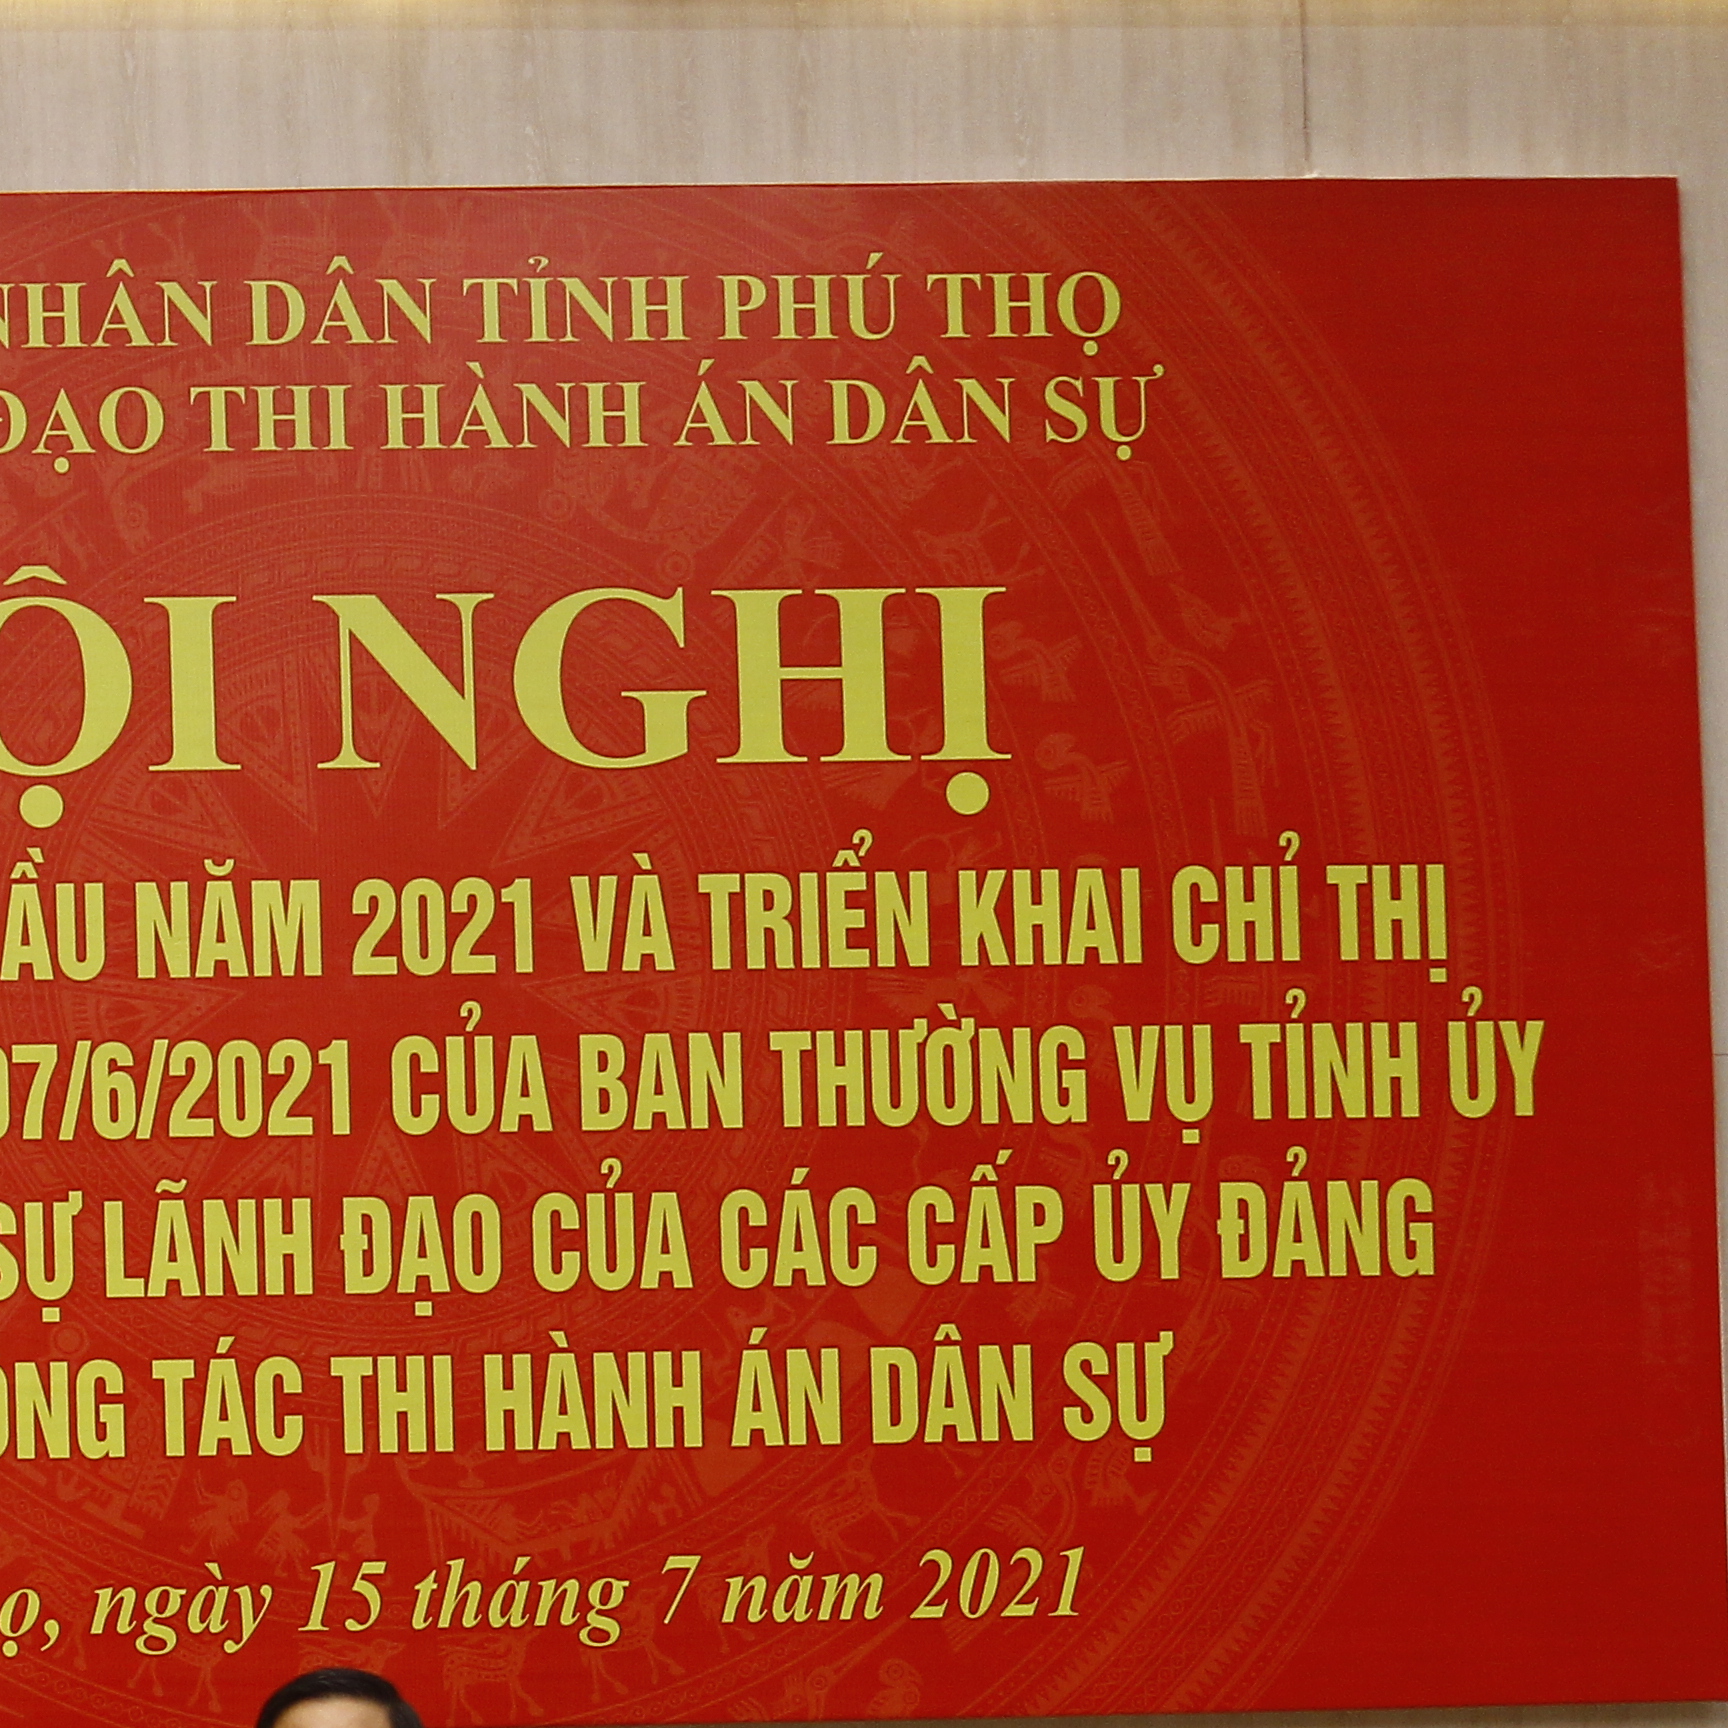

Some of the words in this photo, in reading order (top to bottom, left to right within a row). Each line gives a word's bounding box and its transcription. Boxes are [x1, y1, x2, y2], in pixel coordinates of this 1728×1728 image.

[244, 256, 437, 345] DÂN
[463, 256, 691, 343] TỈNH
[718, 252, 901, 339] PHÚ
[927, 272, 1120, 353] THỌ
[190, 385, 353, 451] THI
[380, 362, 647, 449] HÀNH
[673, 359, 797, 446] ÁN
[825, 356, 1015, 444] DÂN
[1045, 361, 1164, 460] SỰ
[312, 587, 1011, 814] NGHỊ
[135, 859, 322, 978] NĂM
[352, 877, 533, 975] 2021
[570, 853, 675, 972] VÀ
[698, 829, 929, 969] TRIỂN
[959, 868, 1142, 966] KHAI
[1172, 831, 1300, 964] CHỈ
[1327, 864, 1447, 982] THỊ
[392, 1001, 553, 1135] CỦA
[579, 1032, 743, 1130] BAN
[770, 1003, 1087, 1127] THƯỜNG
[1113, 1025, 1213, 1143] VỤ
[1240, 989, 1419, 1119] TỈNH
[1448, 986, 1544, 1118] ỦY
[104, 1179, 313, 1297] LÃNH
[340, 1194, 501, 1316] ĐẠO
[532, 1158, 693, 1292] CỦA
[720, 1168, 877, 1288] CÁC
[908, 1149, 1063, 1285] CẤP
[1094, 1149, 1190, 1281] ỦY
[1217, 1146, 1434, 1278] ĐẢNG
[152, 1336, 303, 1456] TÁC
[330, 1355, 454, 1453] THI
[484, 1331, 702, 1451] HÀNH
[731, 1327, 841, 1446] ÁN
[870, 1324, 1033, 1443] DÂN
[1064, 1331, 1173, 1462] SỰ
[90, 1563, 272, 1655] ngày
[298, 1561, 386, 1631] 15
[412, 1557, 629, 1646] tháng
[662, 1556, 701, 1624] 7
[722, 1553, 883, 1622] năm
[910, 1547, 1084, 1618] 2021
